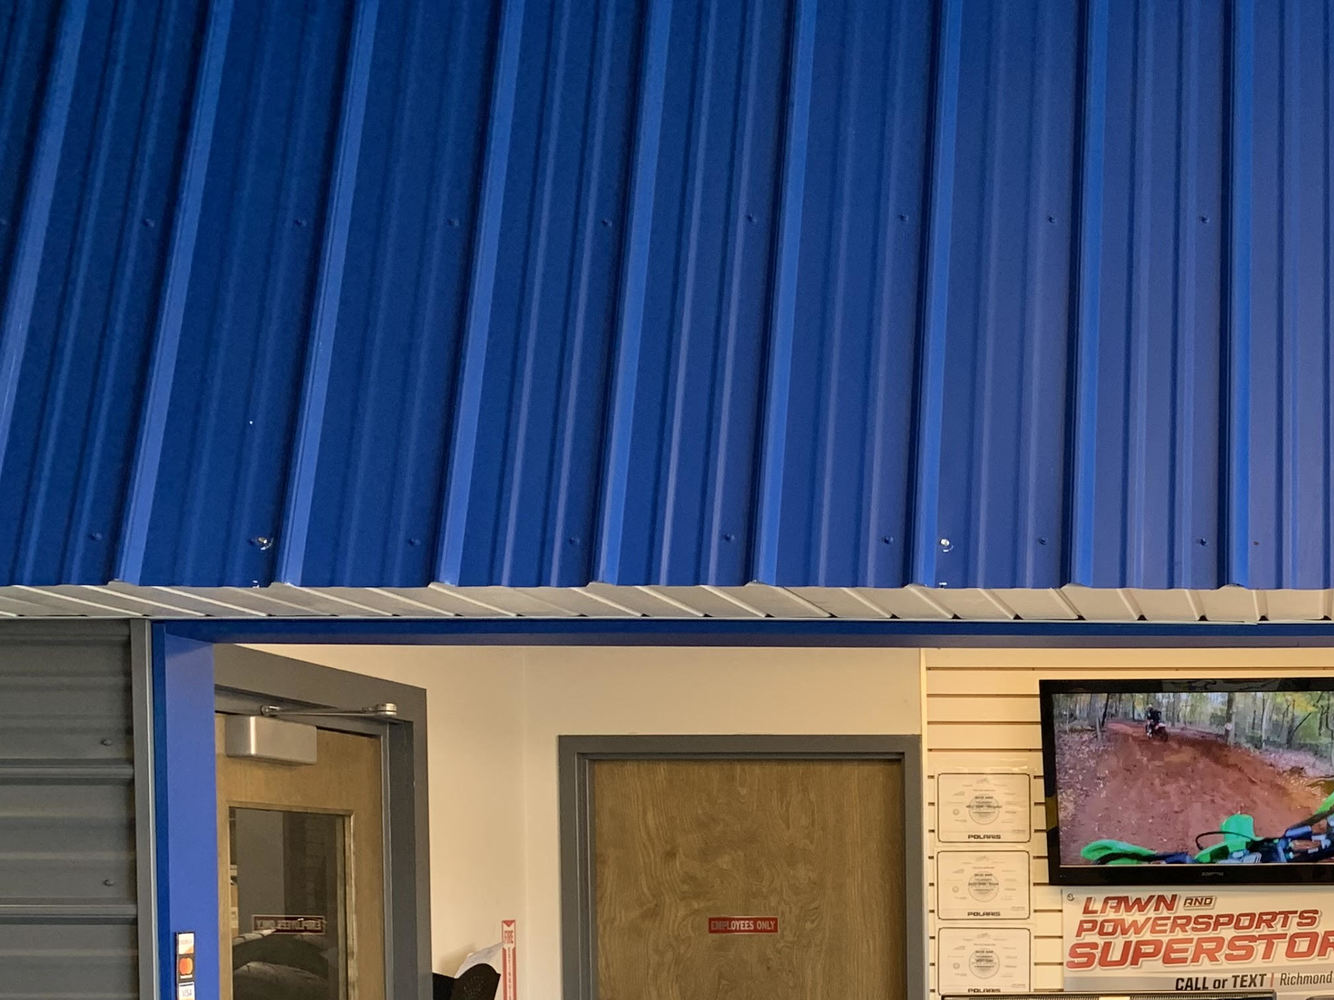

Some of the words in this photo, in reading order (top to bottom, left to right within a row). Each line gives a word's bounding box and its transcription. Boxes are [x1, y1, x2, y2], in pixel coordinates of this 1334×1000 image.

[1082, 894, 1178, 915] LAWN
[1184, 897, 1213, 907] AND
[757, 921, 775, 930] ONLY
[1075, 909, 1319, 937] POWERSPORTS
[1176, 977, 1209, 991] CALL
[1213, 978, 1227, 989] or
[1231, 974, 1267, 988] TEXT
[1279, 971, 1333, 986] Richmond
